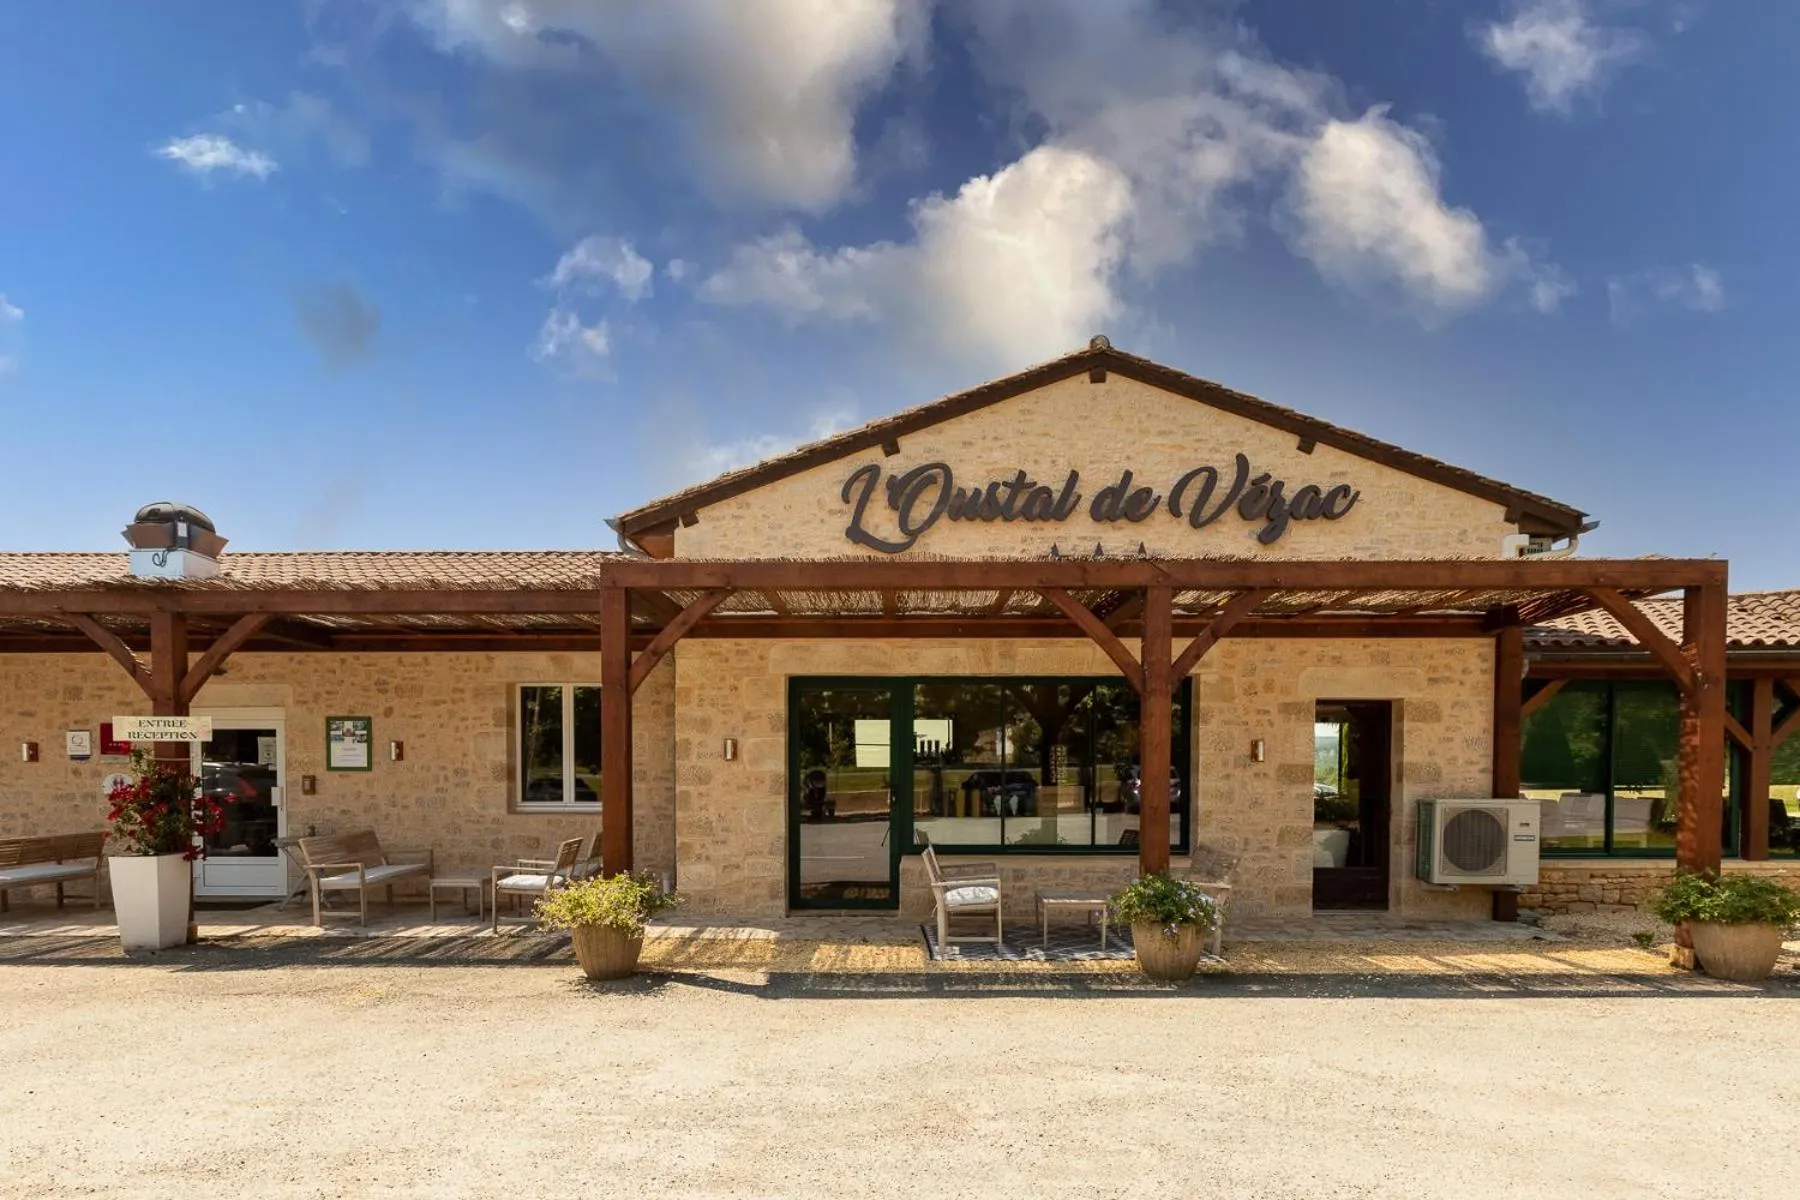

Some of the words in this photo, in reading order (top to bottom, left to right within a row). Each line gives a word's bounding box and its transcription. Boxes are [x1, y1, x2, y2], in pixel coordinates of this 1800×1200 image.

[841, 462, 1083, 553] L'Oustal
[1089, 469, 1162, 522] de
[1168, 452, 1361, 545] Vézac
